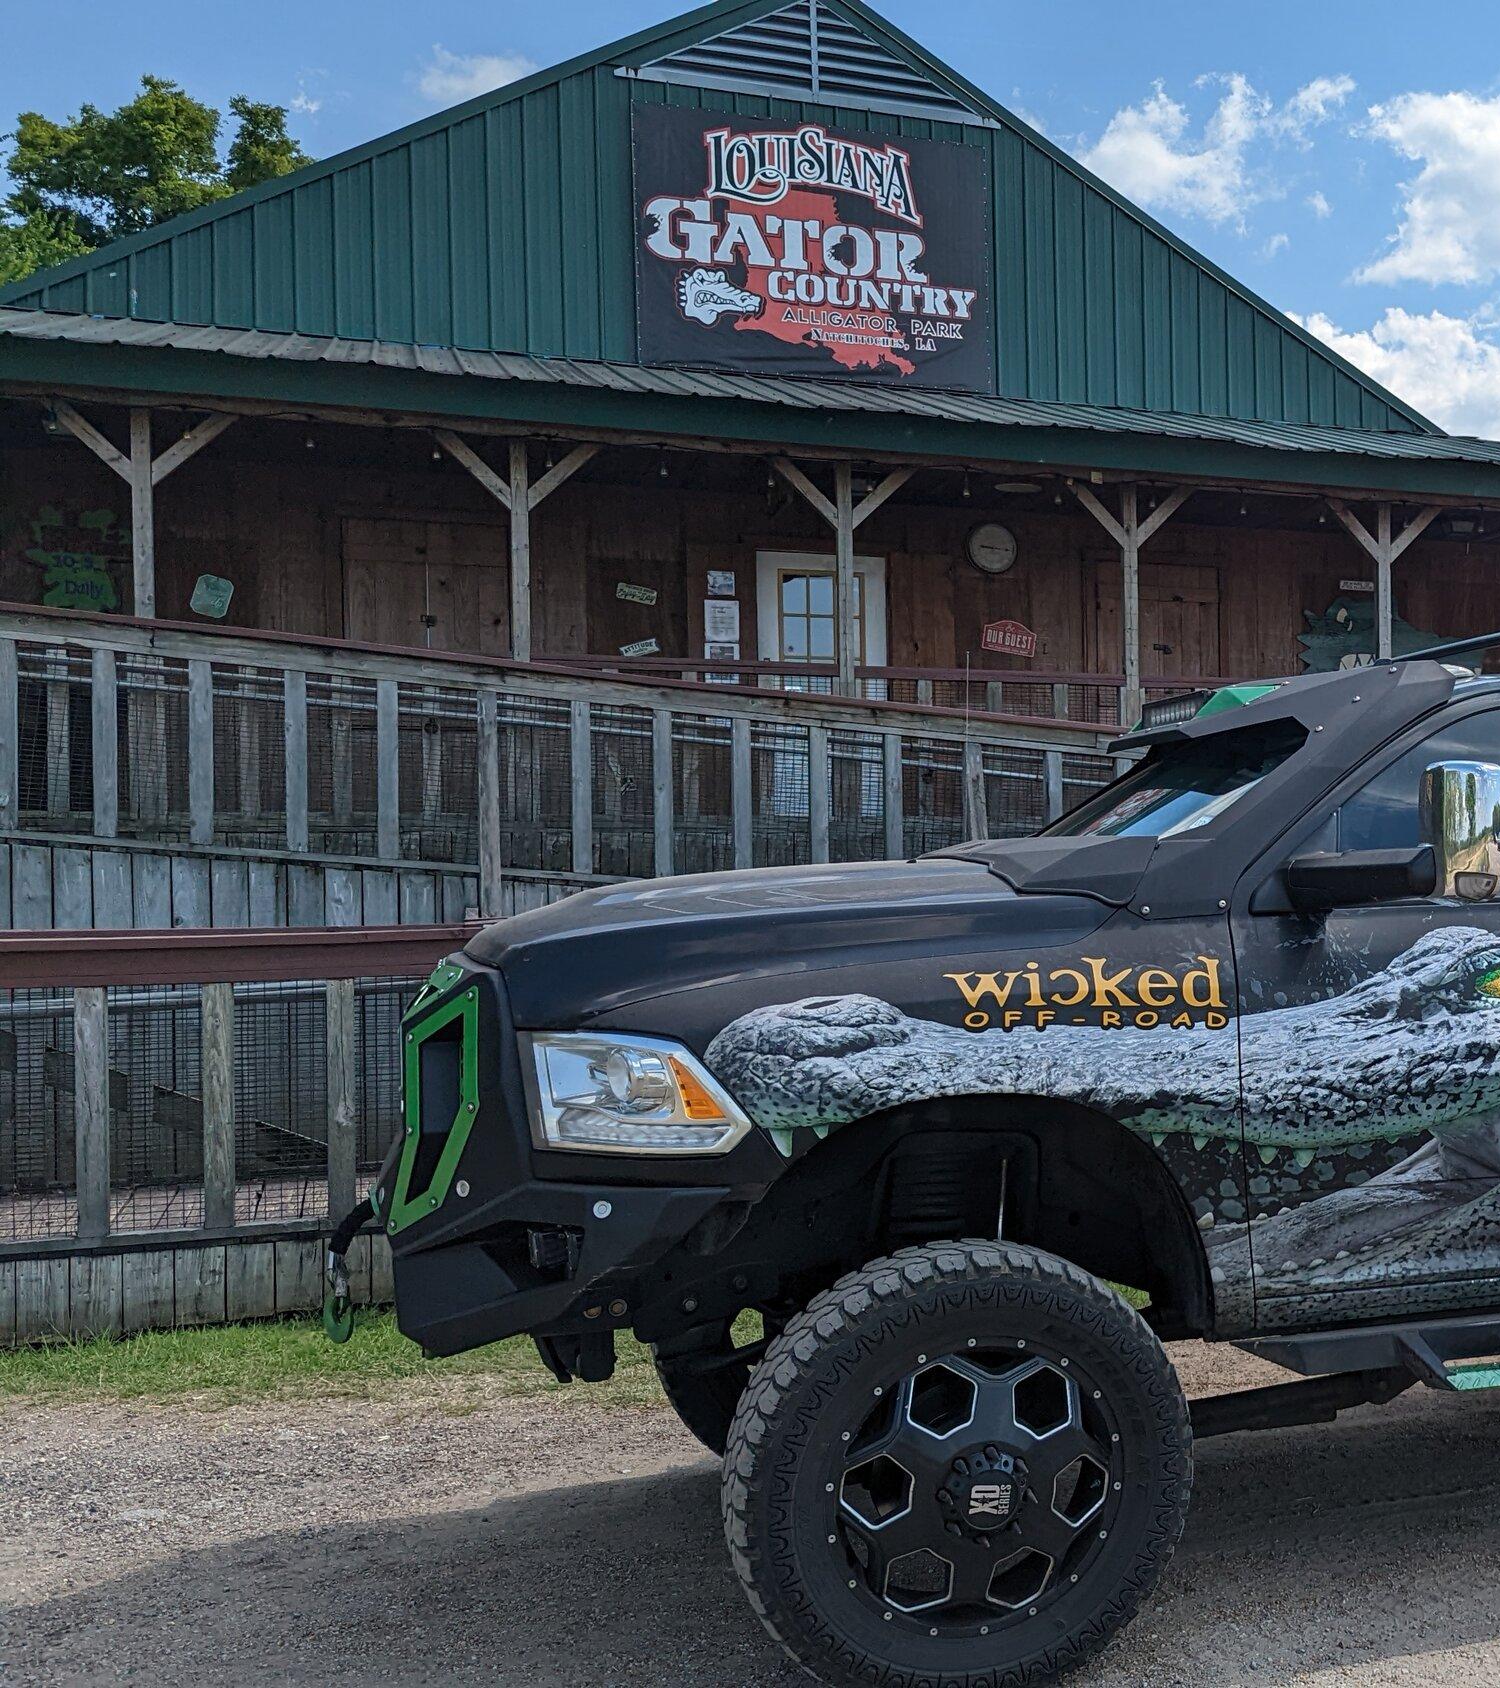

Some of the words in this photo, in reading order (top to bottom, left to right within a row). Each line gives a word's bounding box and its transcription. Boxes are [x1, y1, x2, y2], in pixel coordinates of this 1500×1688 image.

[706, 127, 921, 226] LOUISIANA
[644, 197, 928, 283] GATOR
[768, 271, 976, 319] COUNTRY
[781, 308, 898, 333] ALLIGATOR
[910, 319, 963, 339] PARK
[915, 338, 937, 352] LA
[624, 641, 653, 654] ATTITUDE
[986, 629, 1003, 645] OUR
[1005, 632, 1032, 650] GUEST
[943, 955, 1228, 1008] wicked
[963, 1010, 1229, 1029] OFF-ROAD
[968, 1485, 1000, 1515] XD
[998, 1484, 1011, 1515] SERIES
